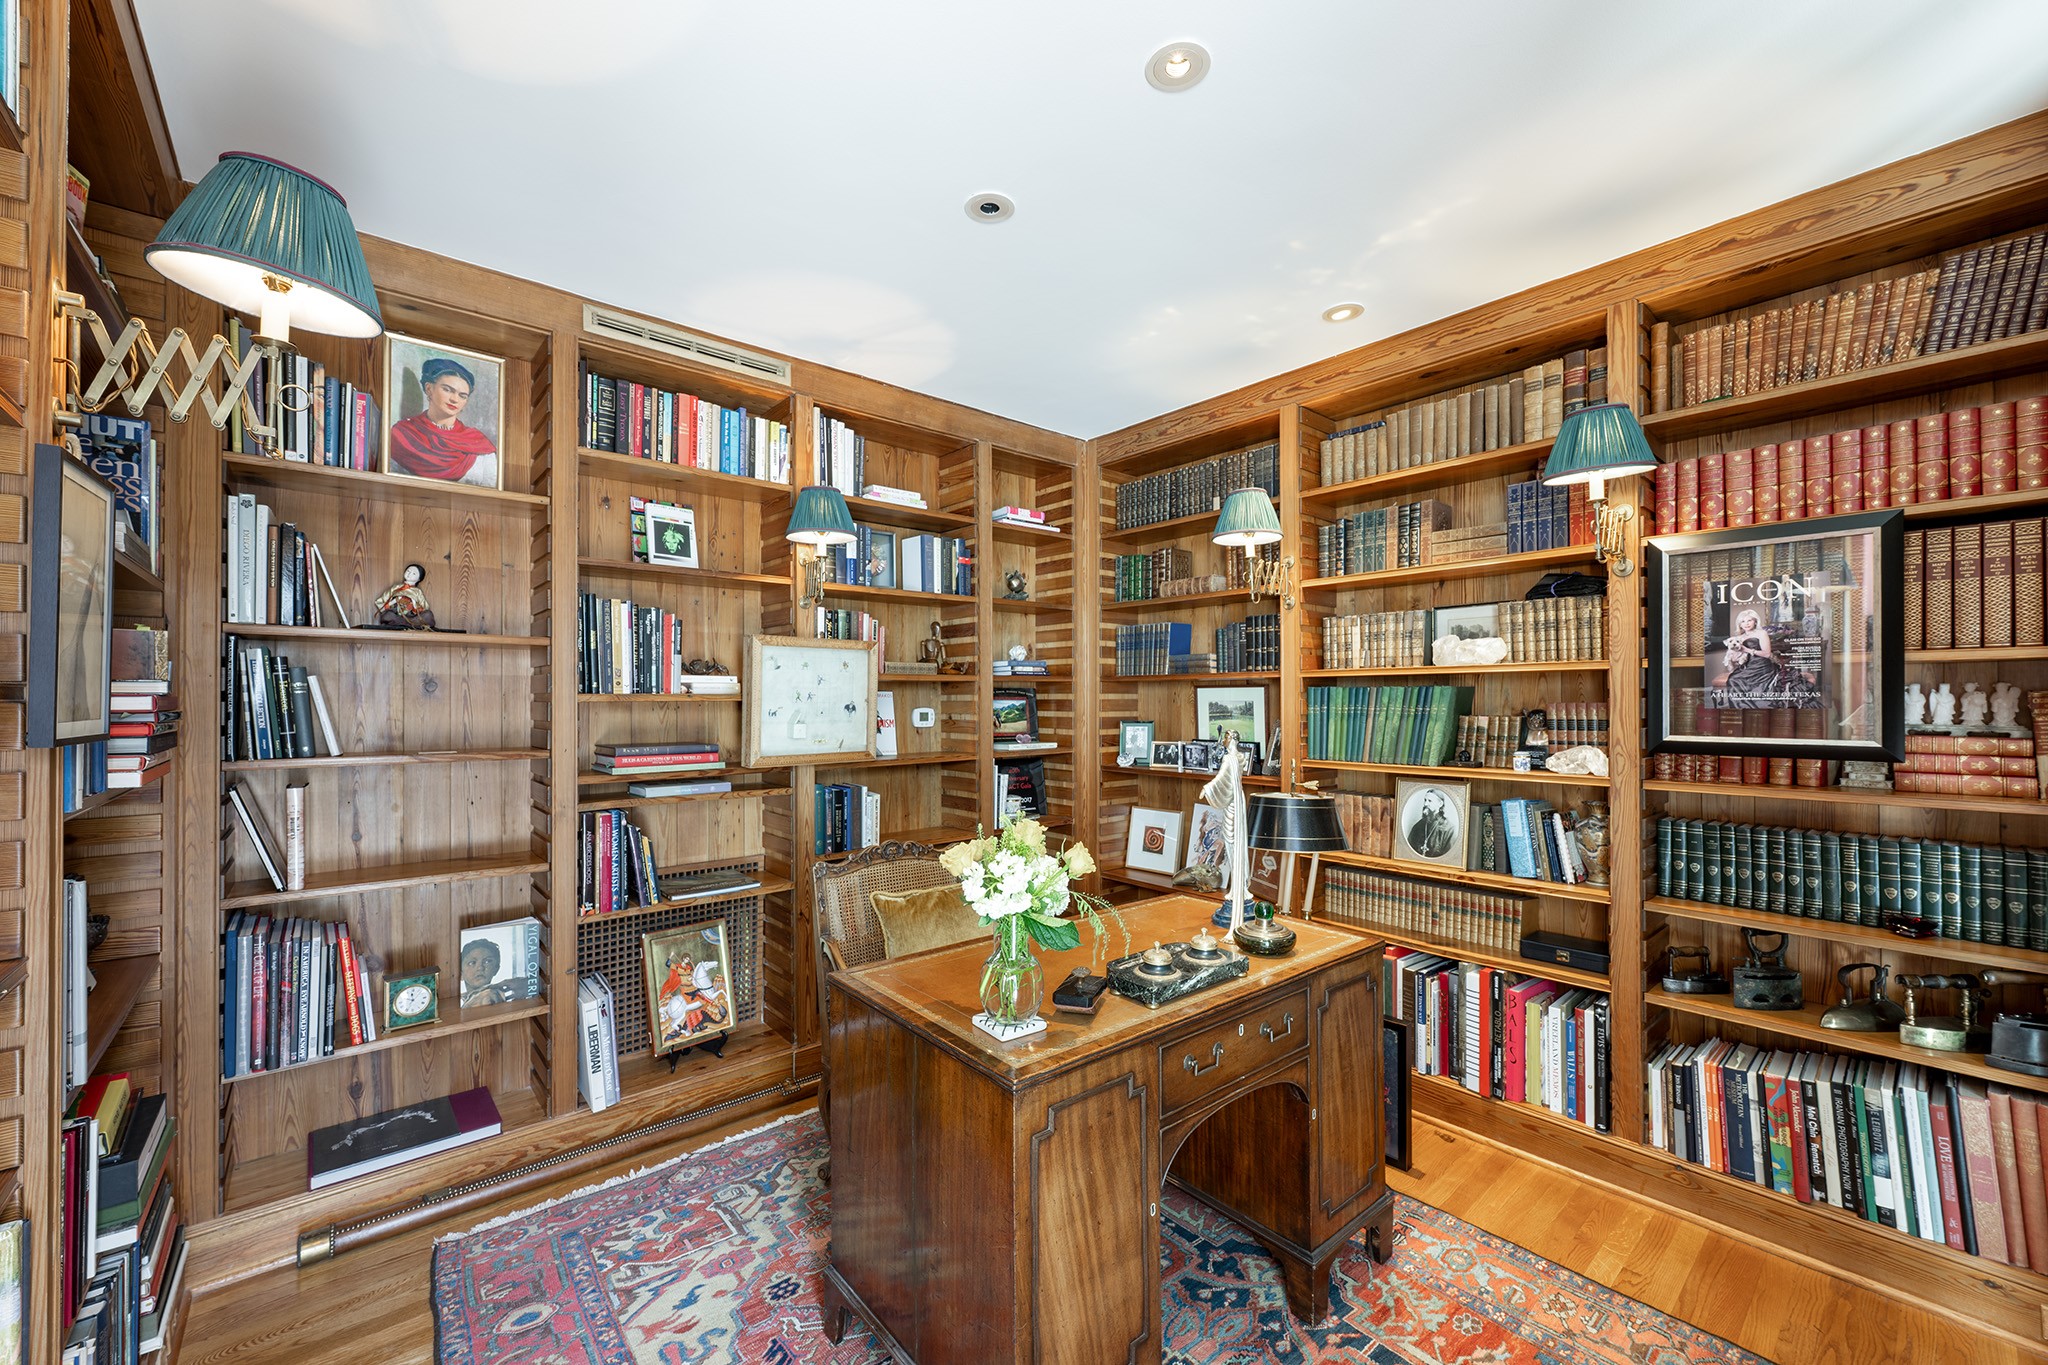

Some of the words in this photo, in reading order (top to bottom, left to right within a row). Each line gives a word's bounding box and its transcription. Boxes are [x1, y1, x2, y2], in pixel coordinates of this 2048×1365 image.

[620, 413, 628, 442] TYCOON
[242, 529, 251, 554] DIEGO
[242, 555, 251, 586] RIVERA
[1717, 576, 1814, 604] ICON
[611, 829, 619, 861] WOMEN
[611, 862, 619, 892] ARTISTS
[528, 923, 538, 958] YIGAL
[301, 955, 309, 987] AMERICA
[527, 962, 537, 1000] OZERI
[300, 1001, 308, 1030] ARNOLD
[345, 971, 356, 1003] SLEEPING
[351, 1016, 360, 1035] DOGS
[1493, 1010, 1502, 1043] RETABLO
[1508, 994, 1518, 1065] BALS
[1552, 1016, 1560, 1066] VREELAND
[1597, 1027, 1605, 1048] ELVIS
[587, 1023, 601, 1075] LIBERMAN
[1597, 1053, 1605, 1061] 21
[1552, 1067, 1560, 1098] MEMOS
[1735, 1073, 1744, 1118] METROPOLITAN
[1790, 1089, 1799, 1103] John
[1792, 1104, 1802, 1133] Alexander
[1807, 1105, 1816, 1120] Mel
[1834, 1097, 1844, 1125] IRANIAN
[1809, 1121, 1818, 1138] Chin
[1871, 1117, 1884, 1152] LEIBOVITZ
[1811, 1142, 1822, 1175] Rematch
[1837, 1125, 1850, 1173] PHOTOGRAPHY
[1937, 1135, 1952, 1163] LOVE
[1875, 1153, 1887, 1177] AMERI
[1843, 1174, 1852, 1190] NOW
